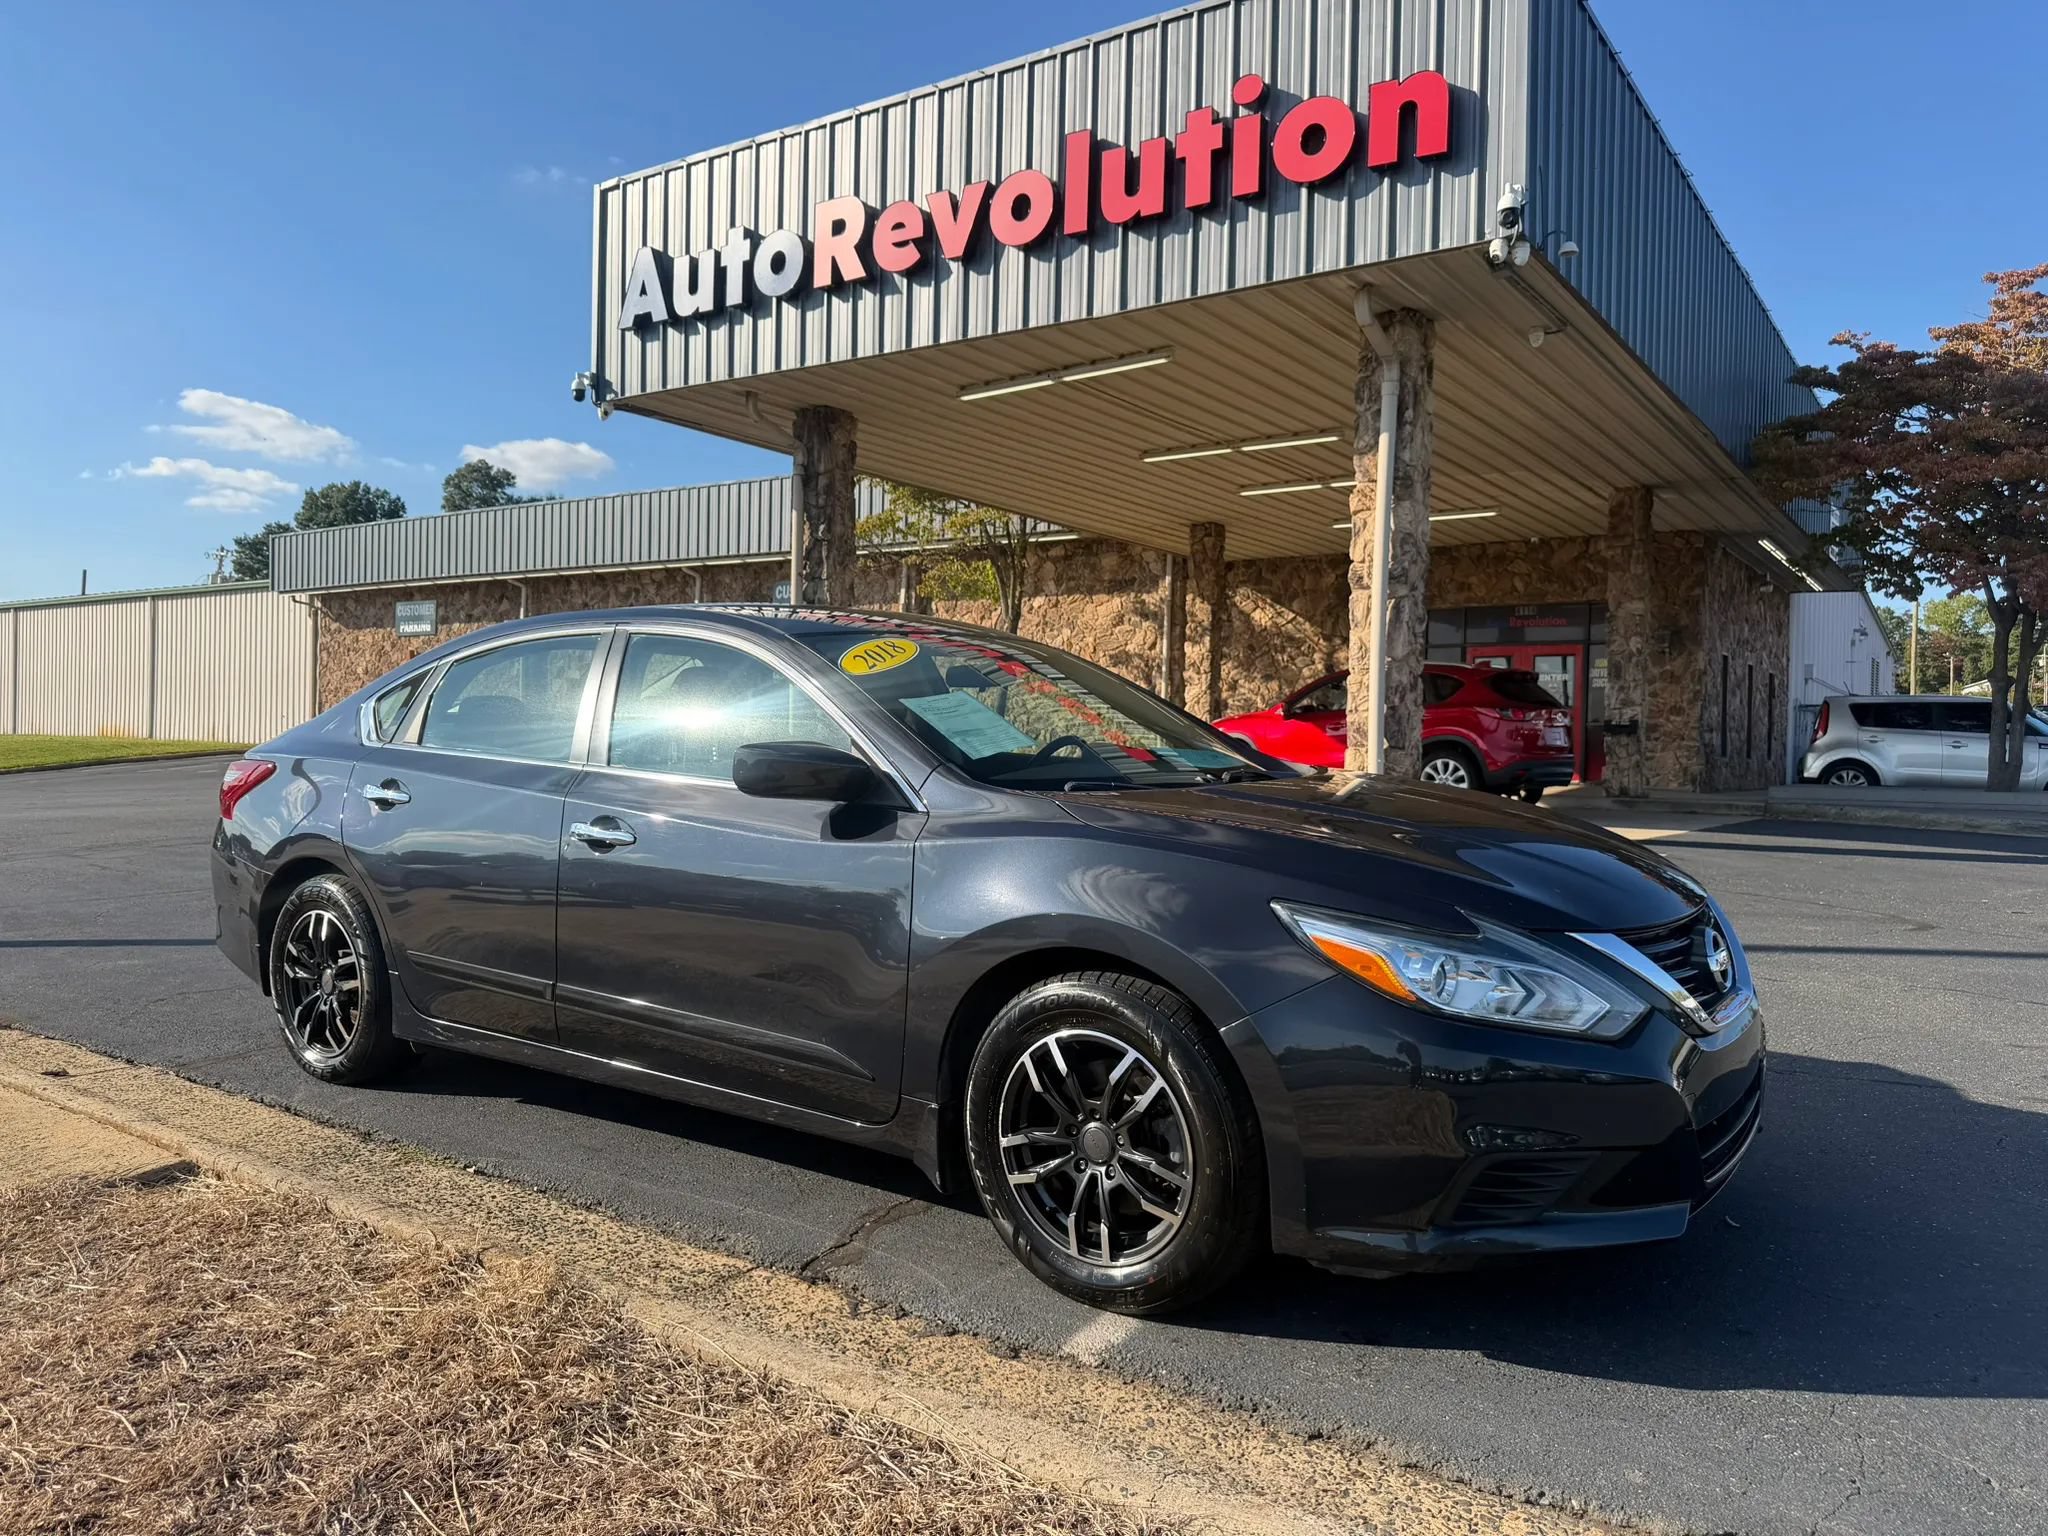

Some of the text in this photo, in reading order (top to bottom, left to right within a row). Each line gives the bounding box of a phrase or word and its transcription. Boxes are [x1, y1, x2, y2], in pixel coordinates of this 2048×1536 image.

[397, 603, 434, 616] CUSTOMER
[400, 620, 431, 633] PARKING
[853, 641, 906, 670] 2018
